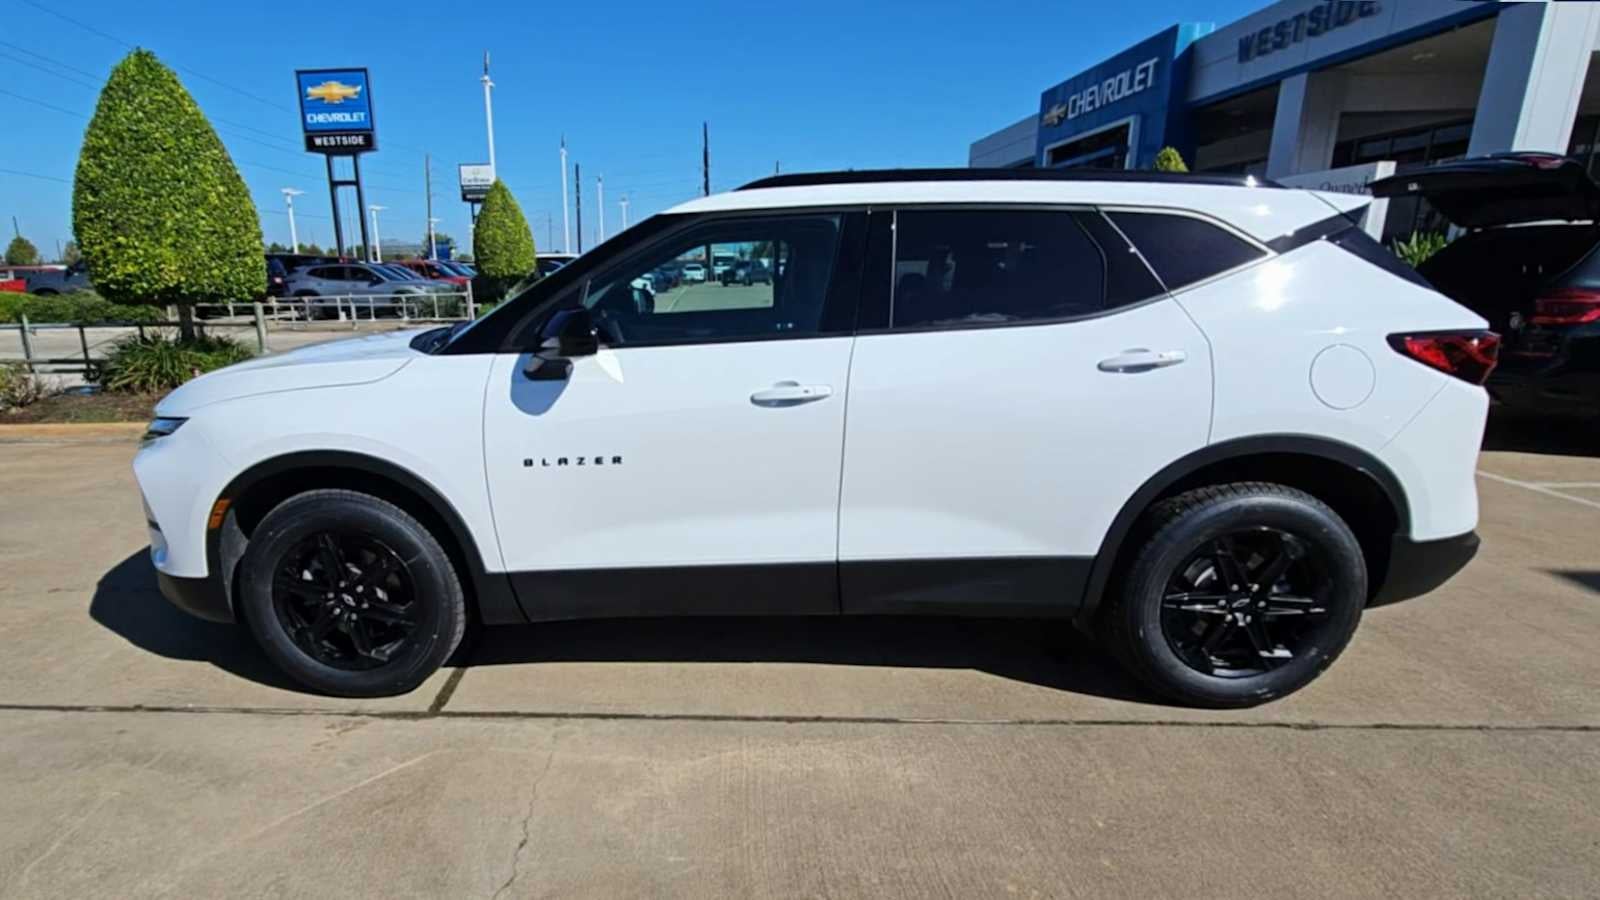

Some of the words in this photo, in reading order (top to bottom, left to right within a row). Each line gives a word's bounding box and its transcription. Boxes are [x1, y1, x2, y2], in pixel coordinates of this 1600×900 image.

[1067, 57, 1159, 119] CHEVROLET
[306, 112, 366, 123] CHEVROLET
[313, 135, 365, 146] WESTSIDE
[523, 456, 622, 467] BLAZER
